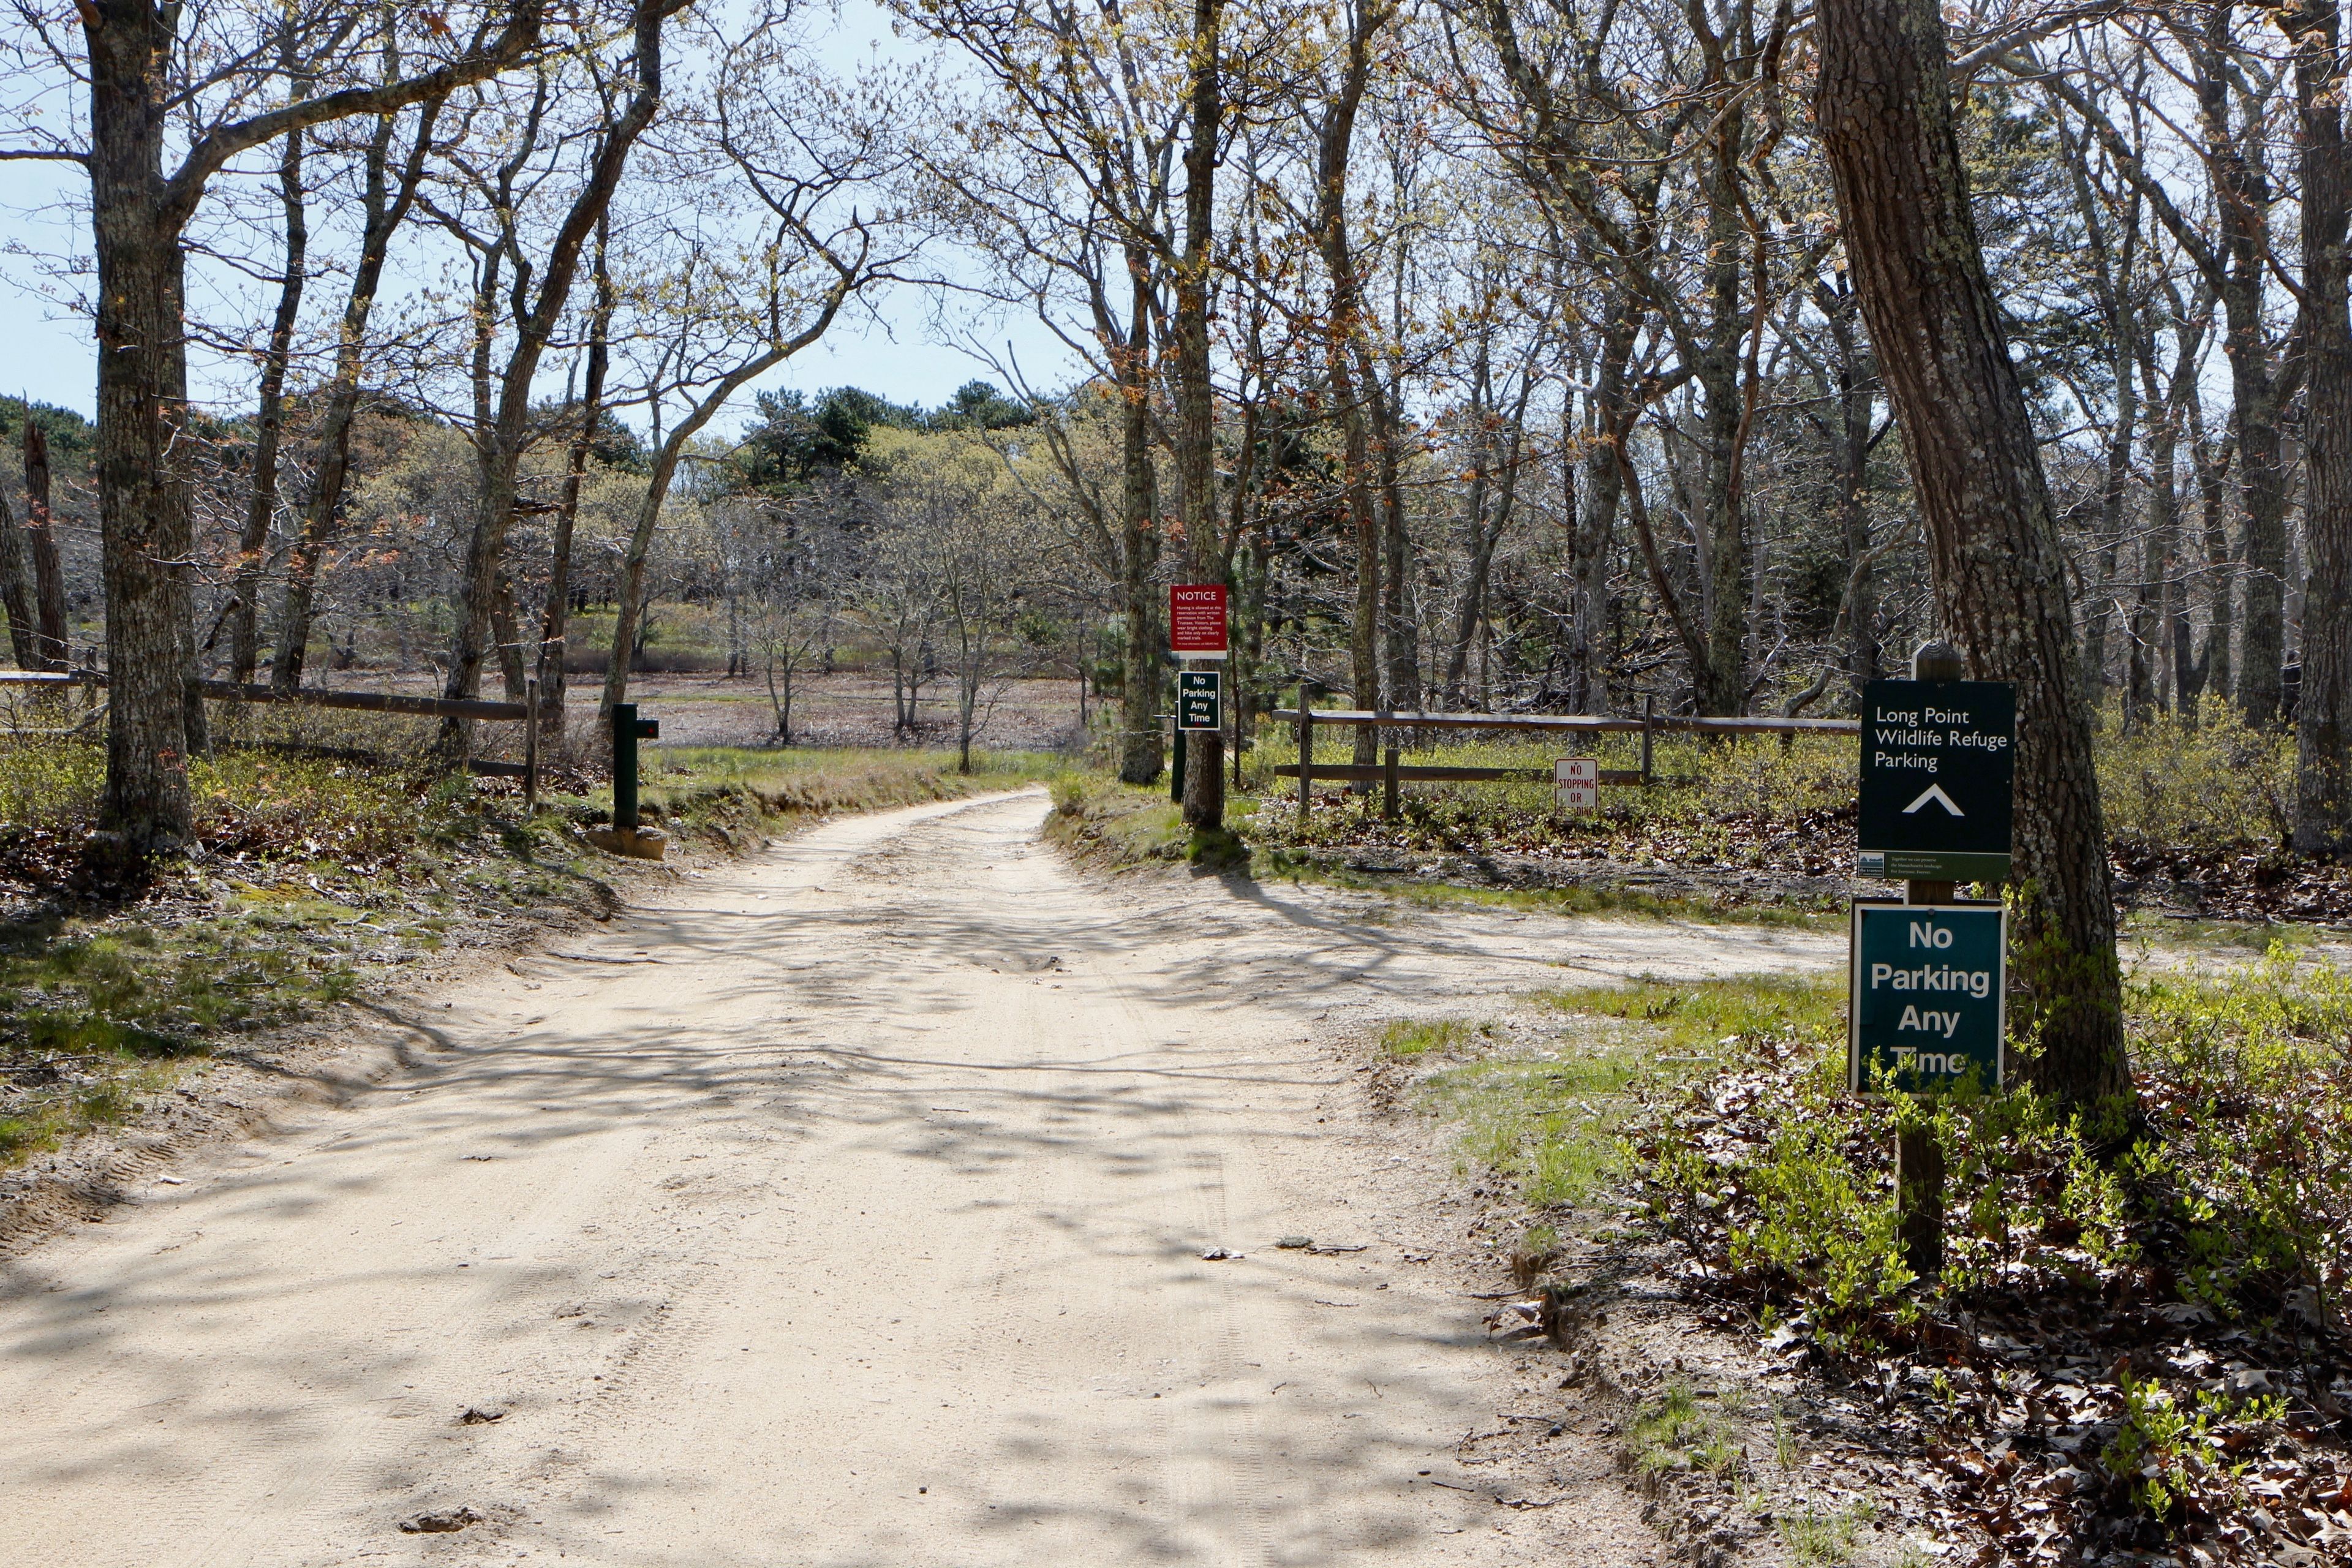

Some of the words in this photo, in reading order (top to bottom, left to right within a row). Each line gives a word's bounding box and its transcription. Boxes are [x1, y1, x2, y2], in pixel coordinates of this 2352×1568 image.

[1177, 592, 1216, 600] NOTICE
[1193, 676, 1205, 685] No
[1183, 688, 1216, 699] Parking
[1191, 701, 1208, 711] Any
[1189, 714, 1210, 722] Time
[1877, 707, 1918, 727] Long
[1925, 707, 1969, 724] Point
[1875, 729, 1942, 746] Wildlife
[1950, 731, 2007, 751] Refuge
[1875, 752, 1938, 772] Parking
[1570, 765, 1581, 775] NO
[1558, 779, 1594, 789] STOPPING
[1570, 793, 1581, 802] OR
[1910, 922, 1953, 948] No
[1872, 963, 1989, 998] Parking
[1898, 1005, 1961, 1038] Any
